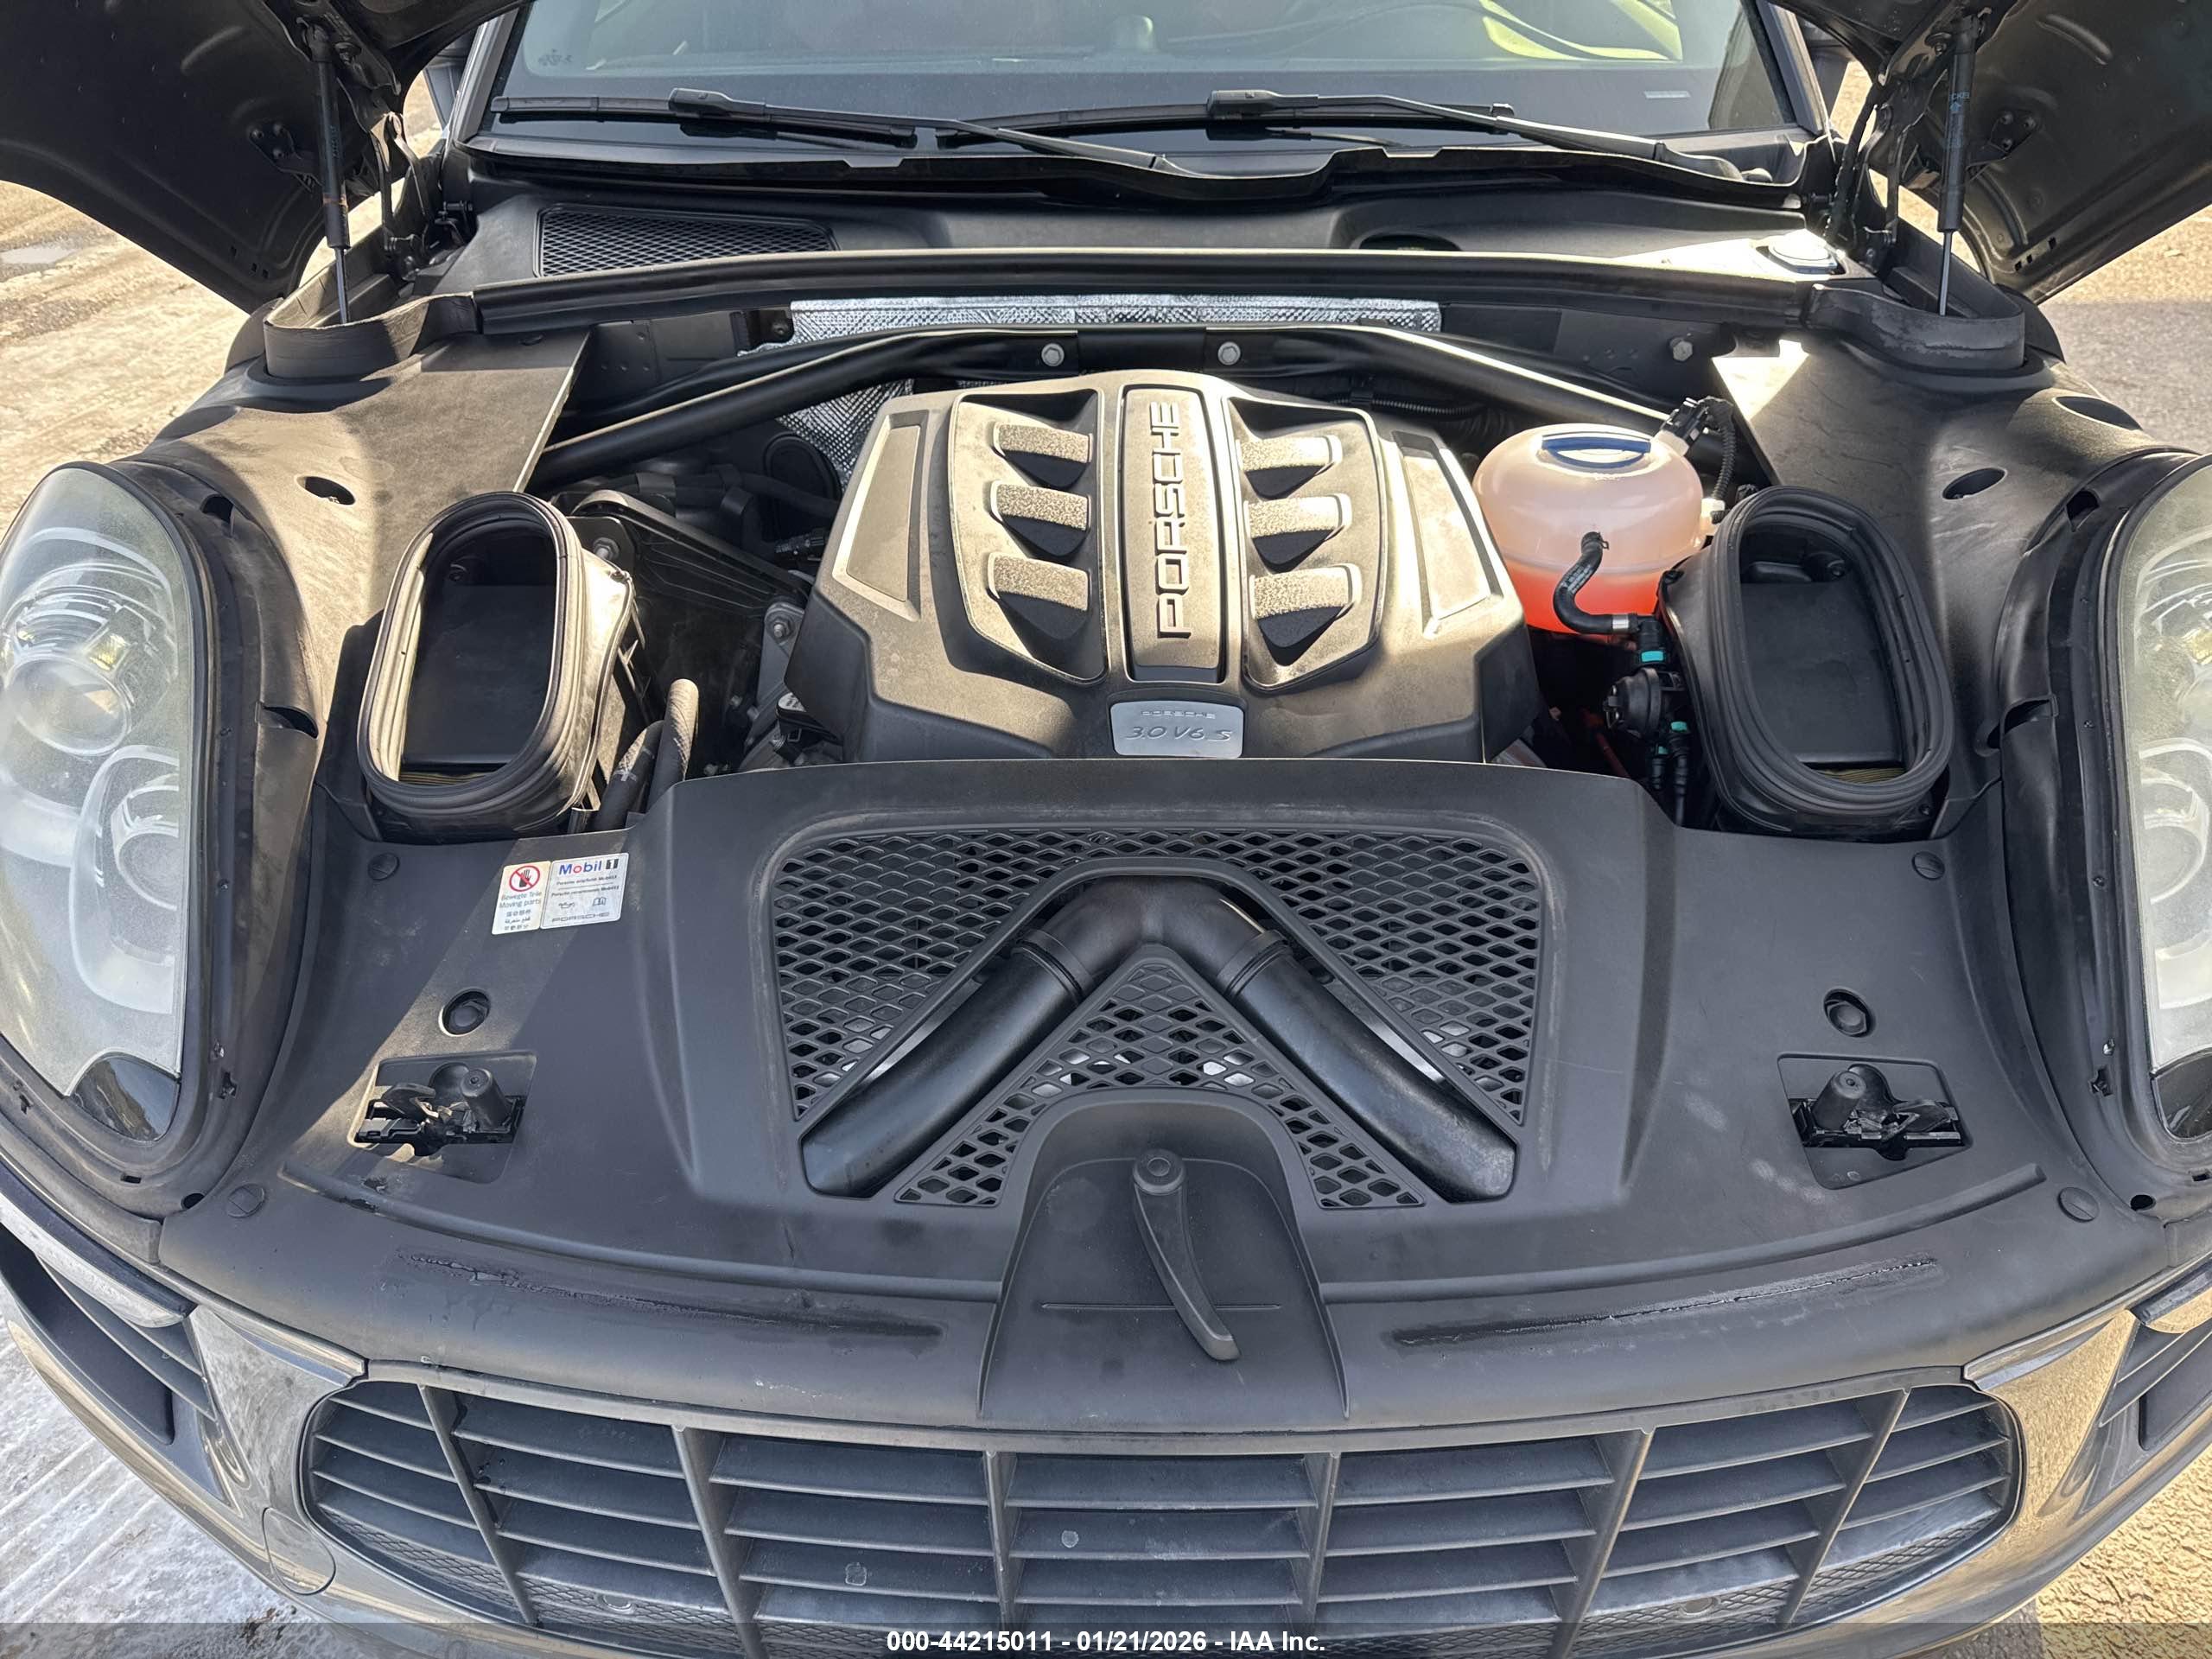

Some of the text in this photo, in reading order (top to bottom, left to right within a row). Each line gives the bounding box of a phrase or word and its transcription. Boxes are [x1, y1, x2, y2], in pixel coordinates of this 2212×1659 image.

[1150, 401, 1192, 639] PORSCHE
[1126, 726, 1167, 741] 3.0
[1206, 729, 1233, 742] S
[559, 858, 620, 876] Mobil 1
[499, 898, 542, 909] Moving parts
[551, 912, 610, 922] PORSCHE
